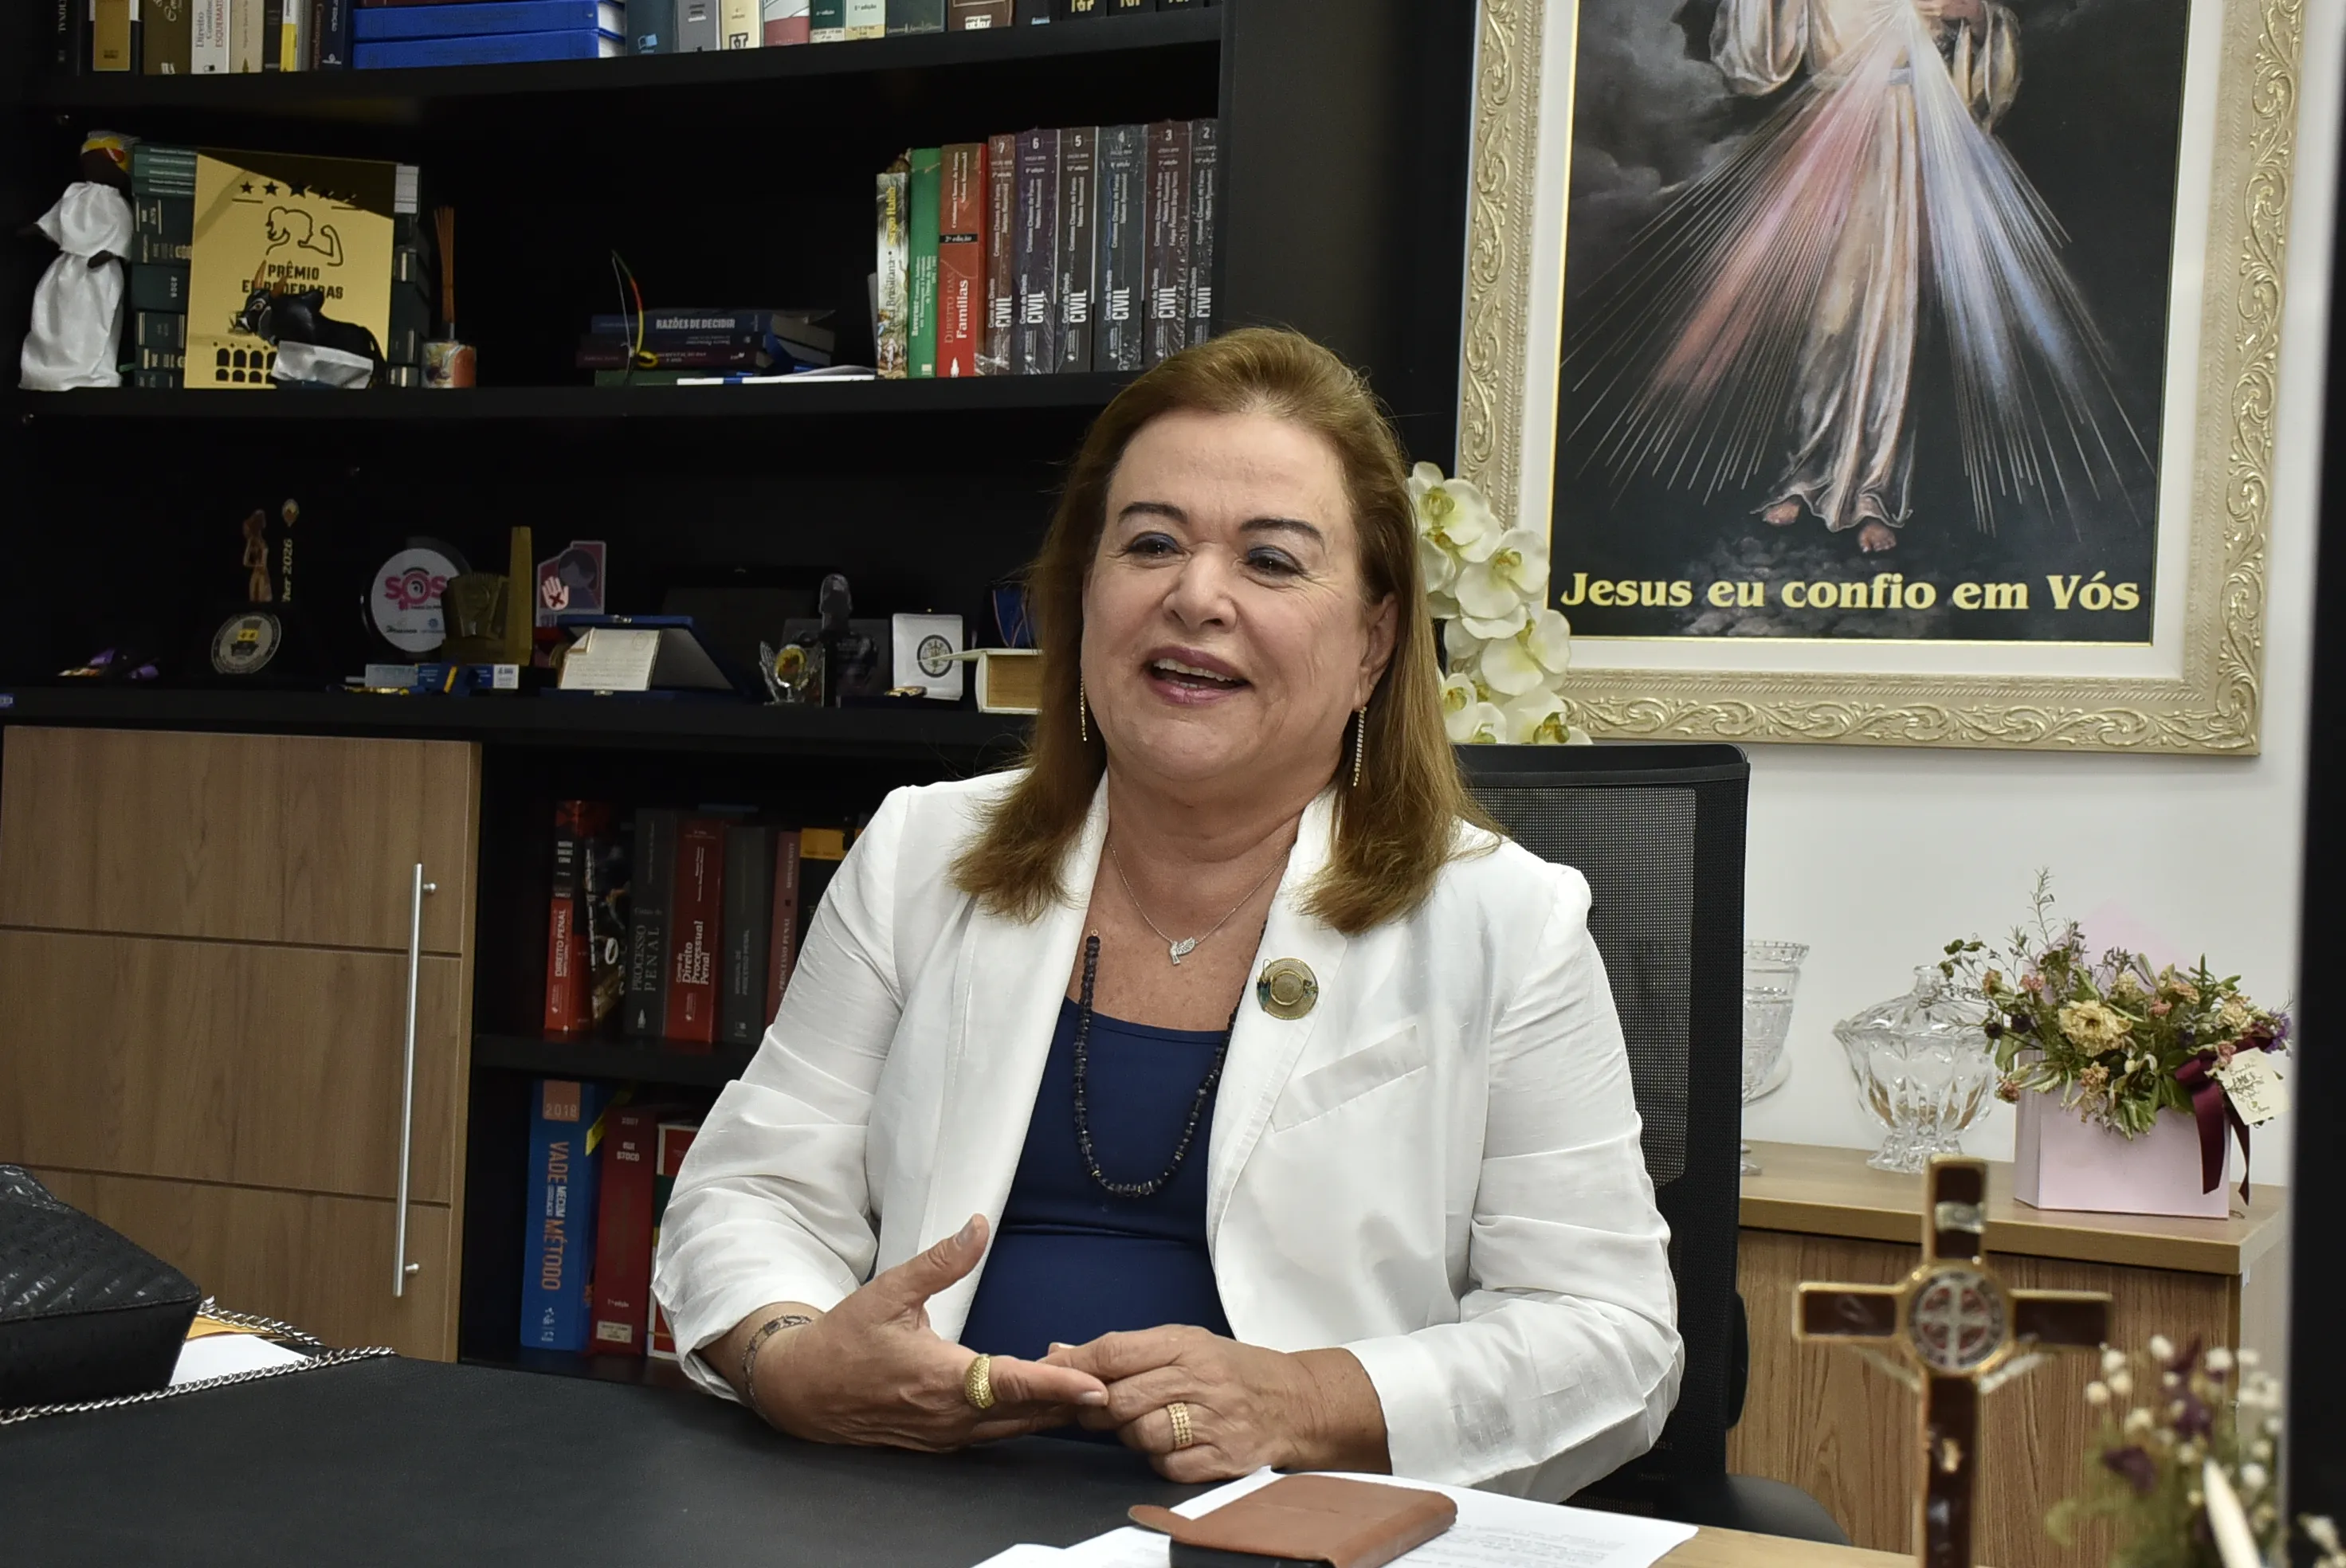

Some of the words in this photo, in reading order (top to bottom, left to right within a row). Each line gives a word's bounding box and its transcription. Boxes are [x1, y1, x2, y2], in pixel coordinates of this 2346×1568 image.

[194, 12, 205, 48] Direito
[999, 141, 1006, 155] 7
[1033, 138, 1039, 149] 6
[1074, 135, 1081, 147] 5
[1118, 130, 1125, 143] 4
[1165, 129, 1172, 141] 3
[1203, 127, 1210, 139] 2
[268, 260, 320, 280] PRÊMIO
[995, 295, 1013, 327] CIVIL
[1026, 290, 1045, 323] CIVIL
[1069, 289, 1087, 323] CIVIL
[1112, 286, 1130, 320] CIVIL
[1158, 284, 1176, 319] CIVIL
[656, 316, 689, 330] RAZÕES
[690, 317, 700, 329] DE
[701, 318, 736, 329] DECIDIR
[944, 297, 955, 344] DIREITO
[1560, 571, 1693, 609] Jesus
[1707, 580, 1765, 609] eu
[1780, 572, 1936, 610] confio
[1952, 583, 2029, 610] em
[2046, 571, 2140, 610] Vós
[557, 908, 567, 939] PENAL
[555, 939, 565, 977] DIREITO
[632, 924, 647, 992] PROCESSO
[644, 926, 661, 992] PENAL
[682, 942, 693, 983] Direito
[692, 919, 704, 985] Processual
[700, 951, 711, 986] Penal
[545, 1103, 578, 1119] 2018
[547, 1141, 571, 1184] VADE
[616, 1151, 641, 1162] STOCO
[622, 1141, 636, 1151] RUI
[556, 1186, 567, 1217] MECUM
[541, 1218, 569, 1292] MÉTODO
